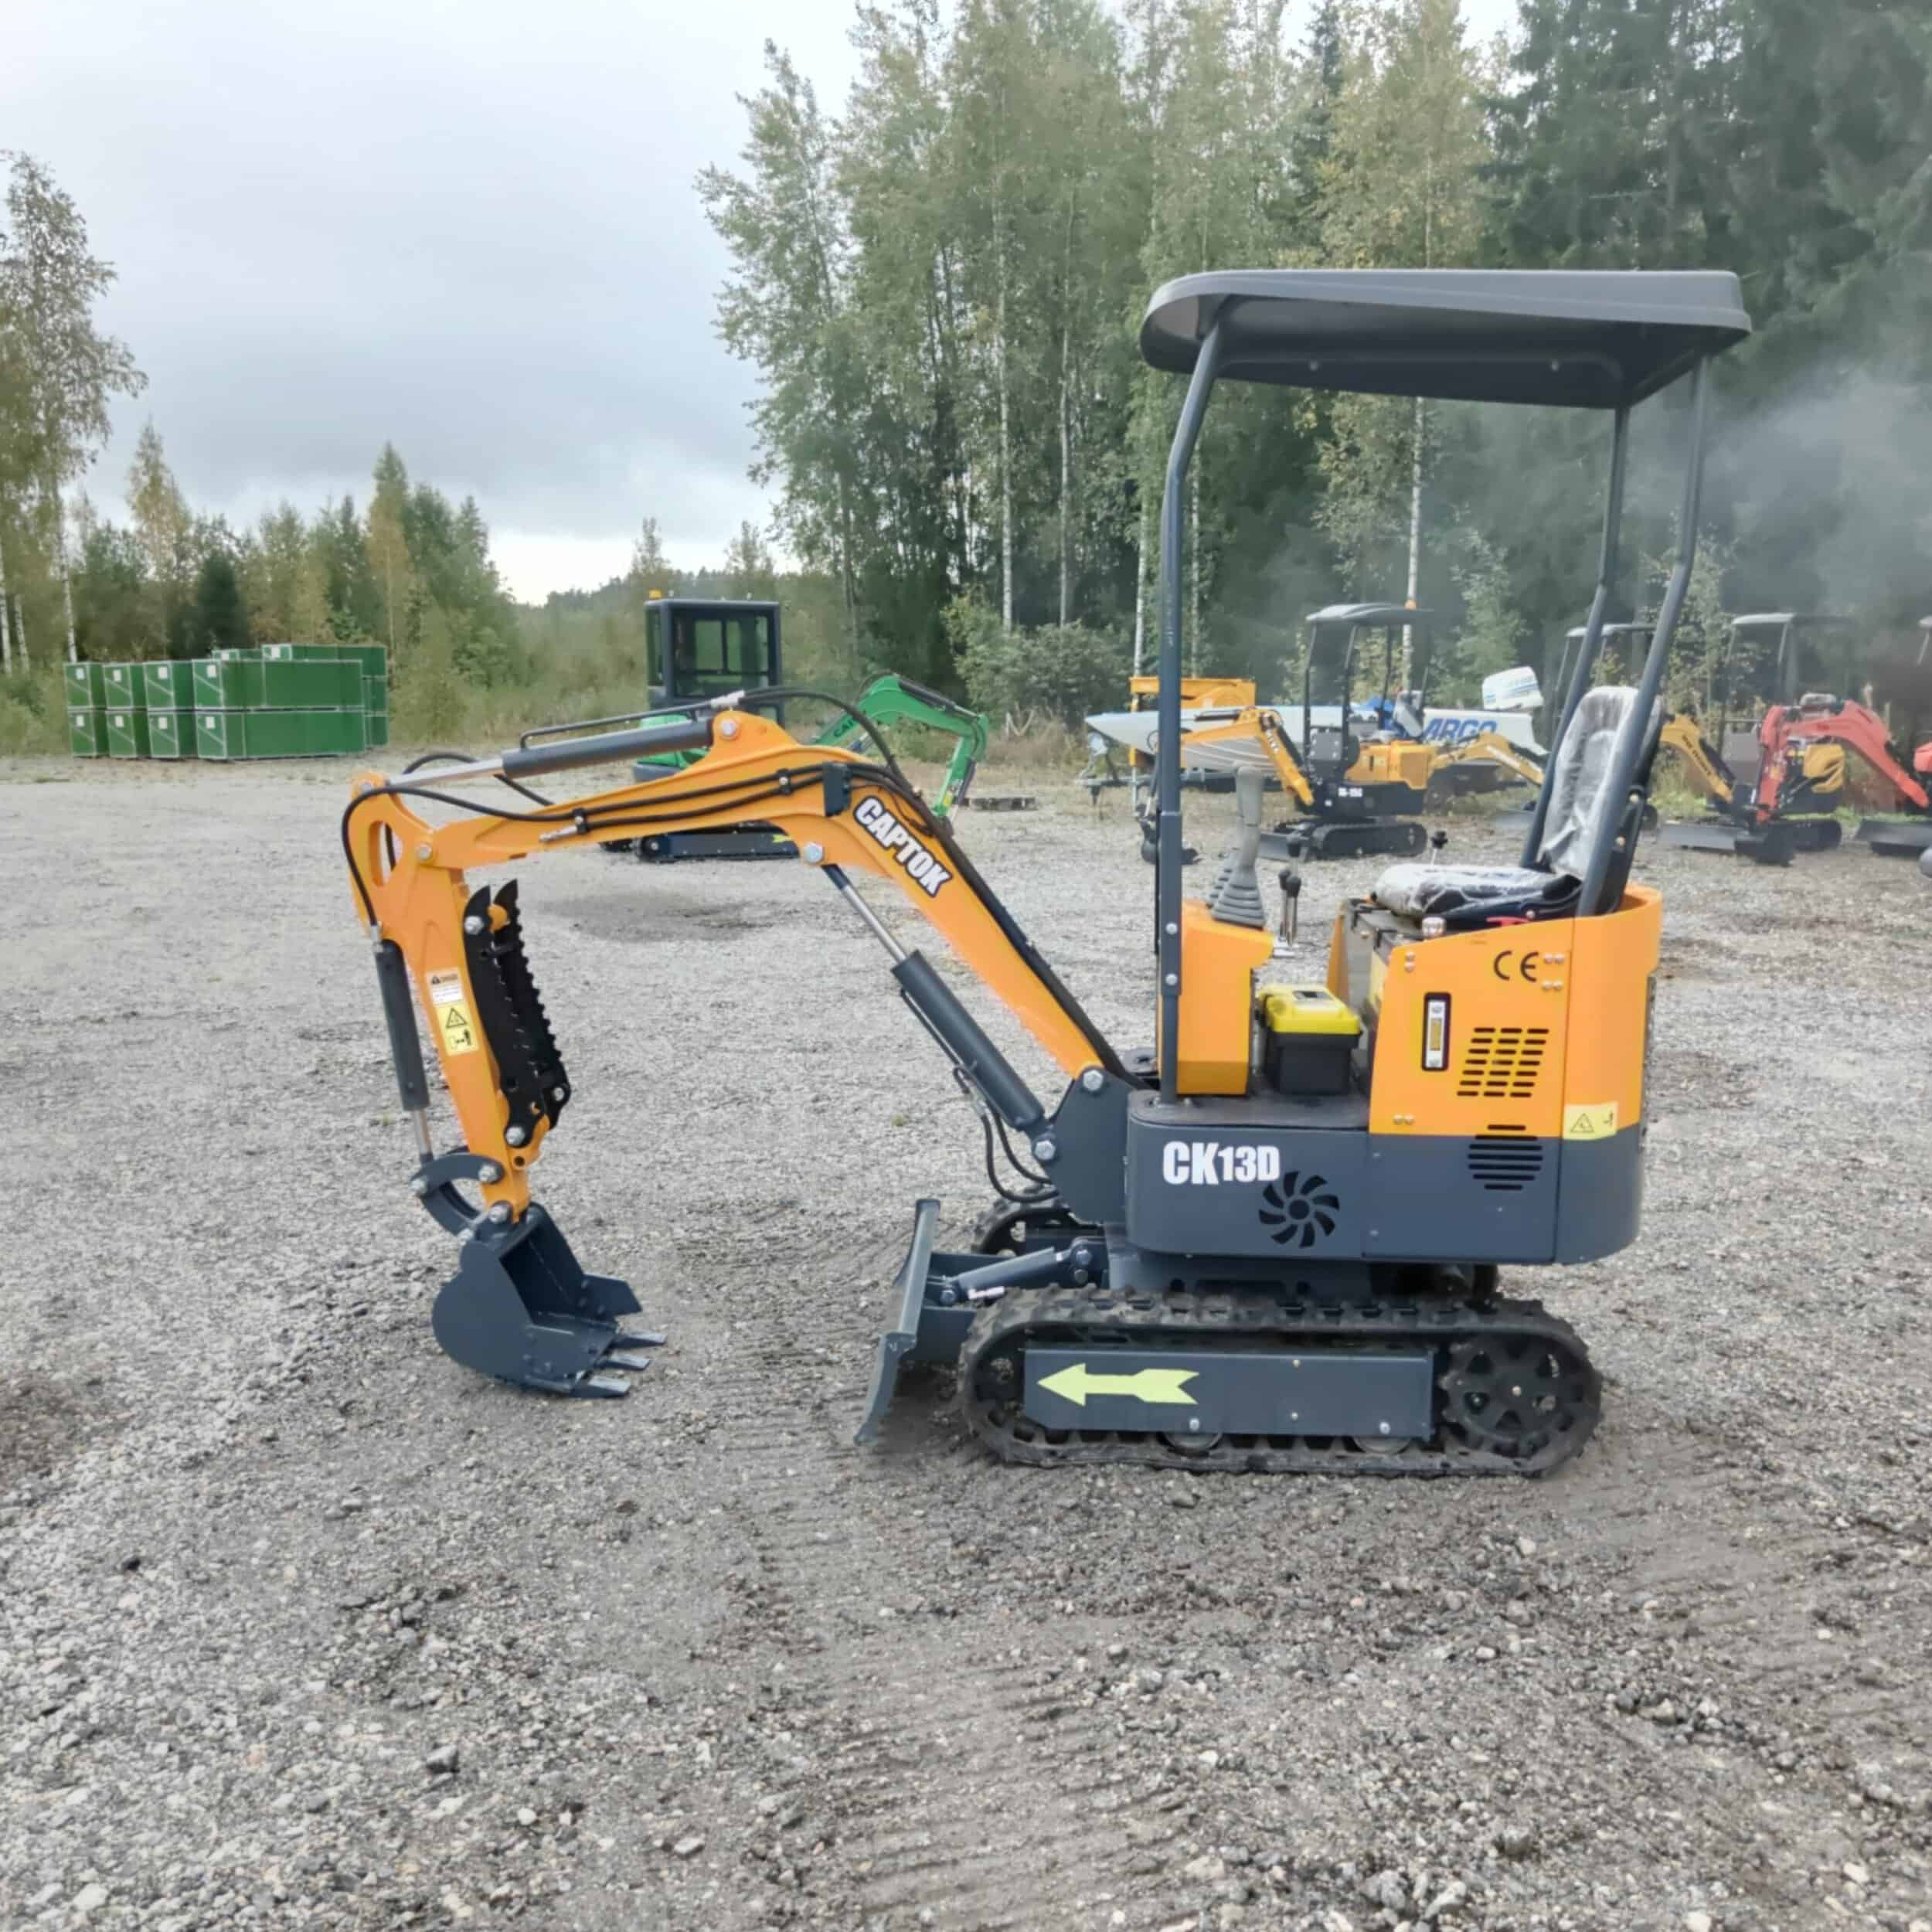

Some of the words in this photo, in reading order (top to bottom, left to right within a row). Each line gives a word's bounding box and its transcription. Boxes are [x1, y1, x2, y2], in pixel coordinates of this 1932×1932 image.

[855, 797, 952, 896] CAPTOK
[1493, 950, 1539, 982] CE
[1162, 1141, 1281, 1185] CK13D
